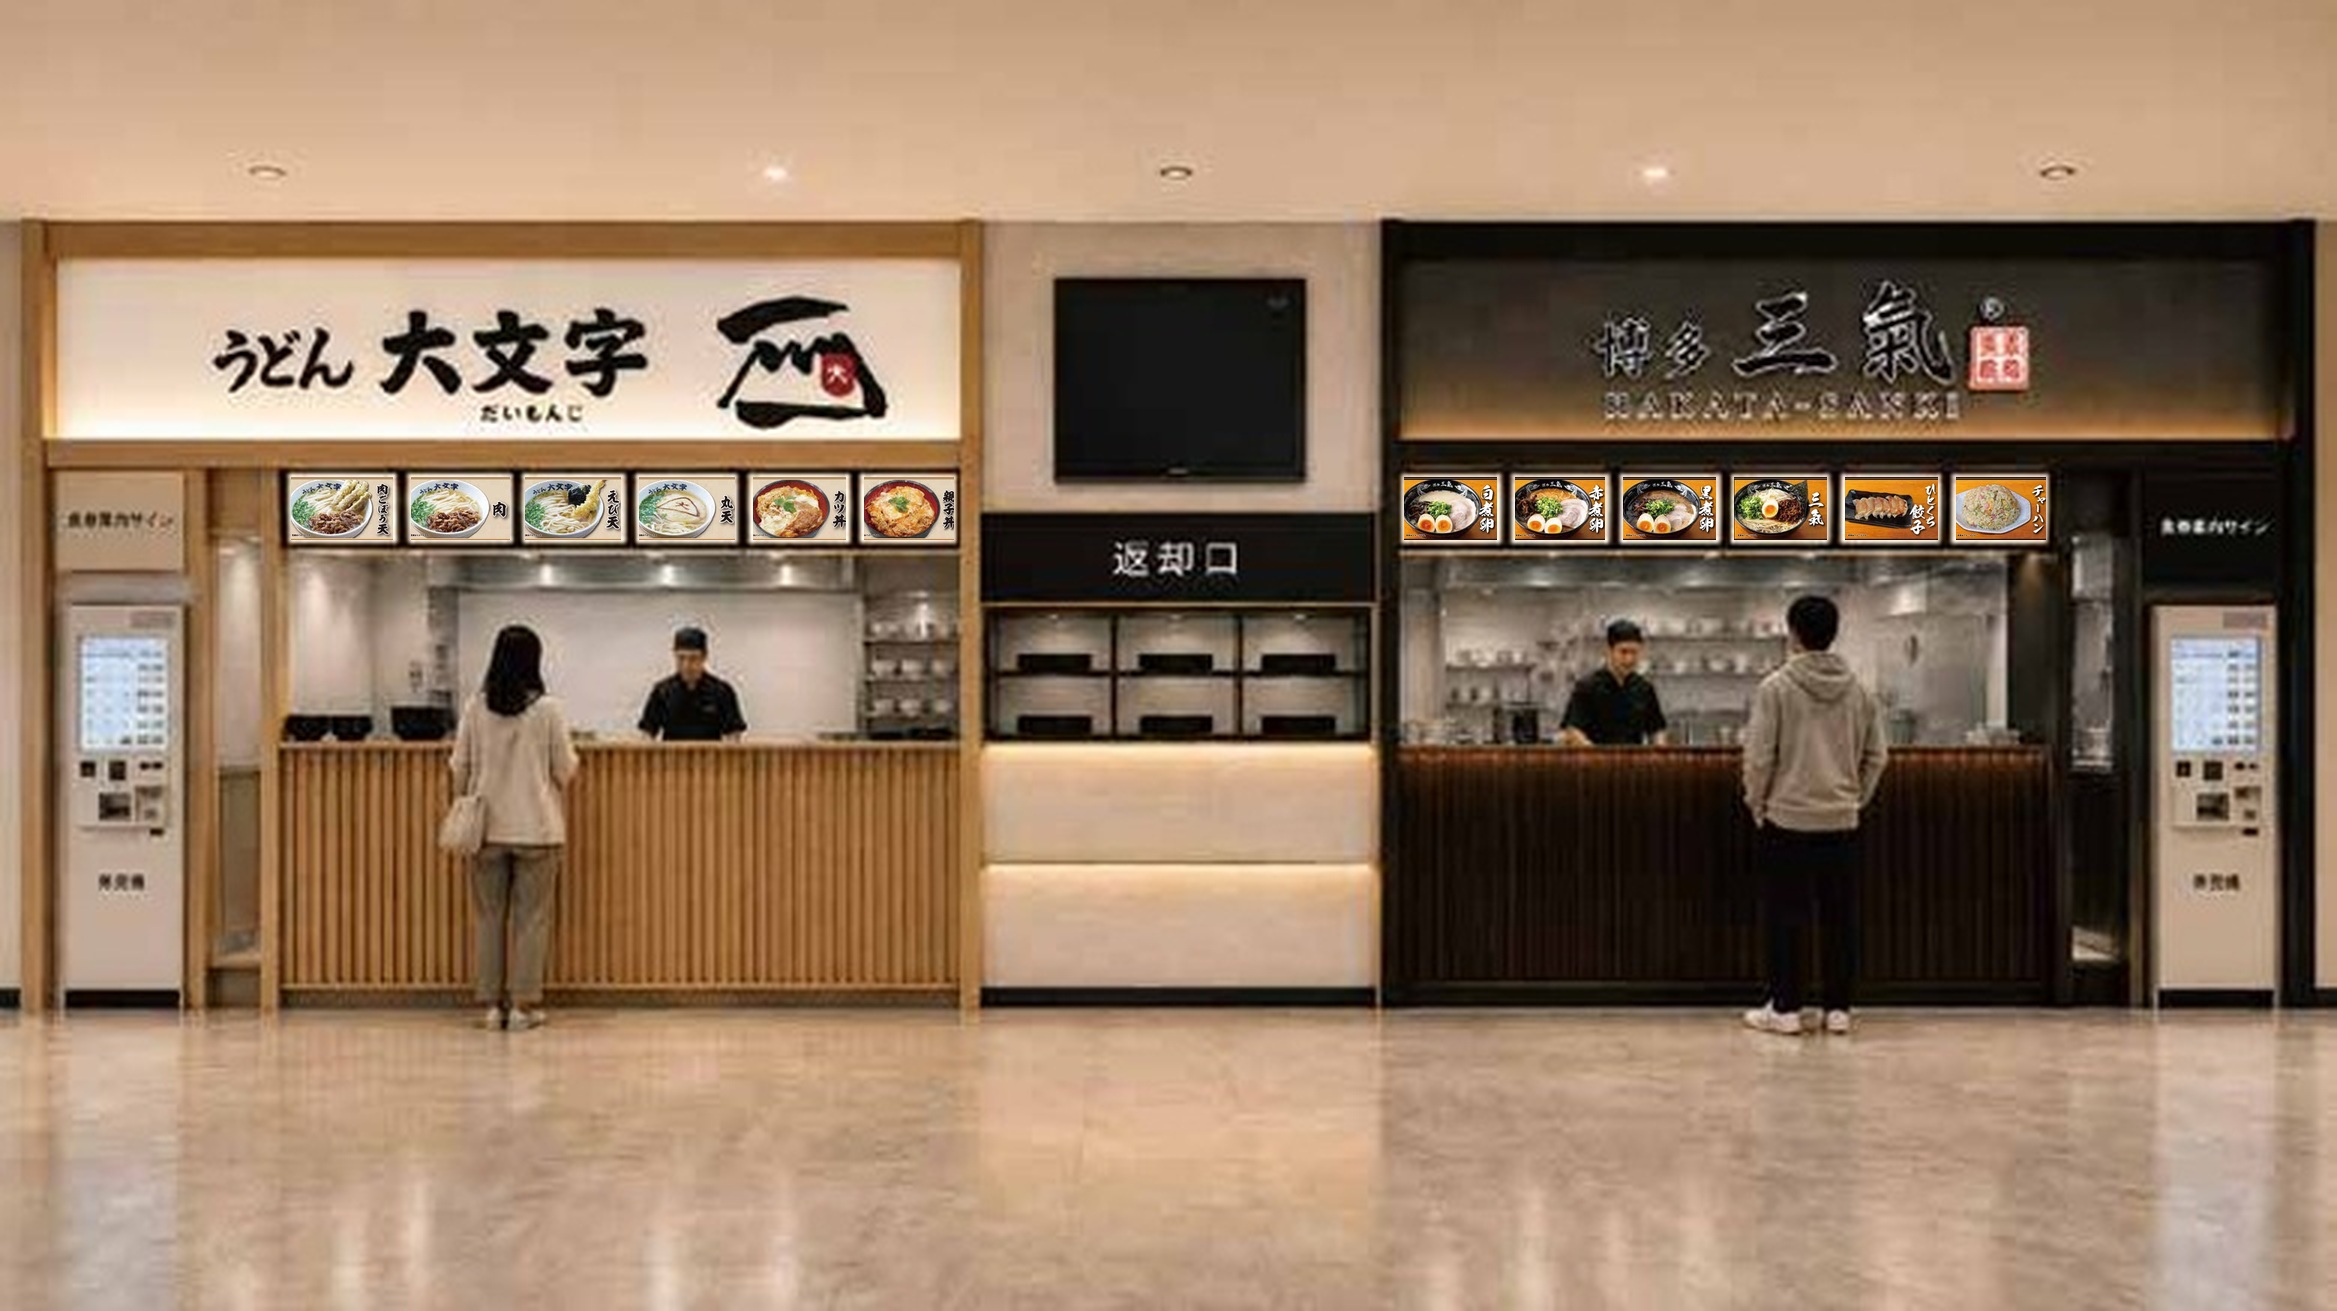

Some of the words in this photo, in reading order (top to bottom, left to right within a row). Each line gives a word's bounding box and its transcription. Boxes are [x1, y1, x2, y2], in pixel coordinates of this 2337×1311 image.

[213, 327, 354, 393] うどん
[380, 308, 648, 397] 大文字
[1596, 317, 1710, 379] 博多
[481, 404, 583, 422] だいもんじ
[492, 501, 507, 517] 肉
[606, 490, 620, 529] えび天
[720, 495, 734, 524] 丸天
[832, 490, 846, 528] カツ丼
[1479, 484, 1495, 534] 白煮卵
[1588, 484, 1604, 534] 赤煮卵
[1698, 484, 1715, 533] 黒煮卵
[1909, 504, 1926, 535] 餃子
[1925, 483, 1936, 528] ひとくち
[2032, 484, 2046, 534] チャーハン
[1113, 541, 1238, 577] 返却口
